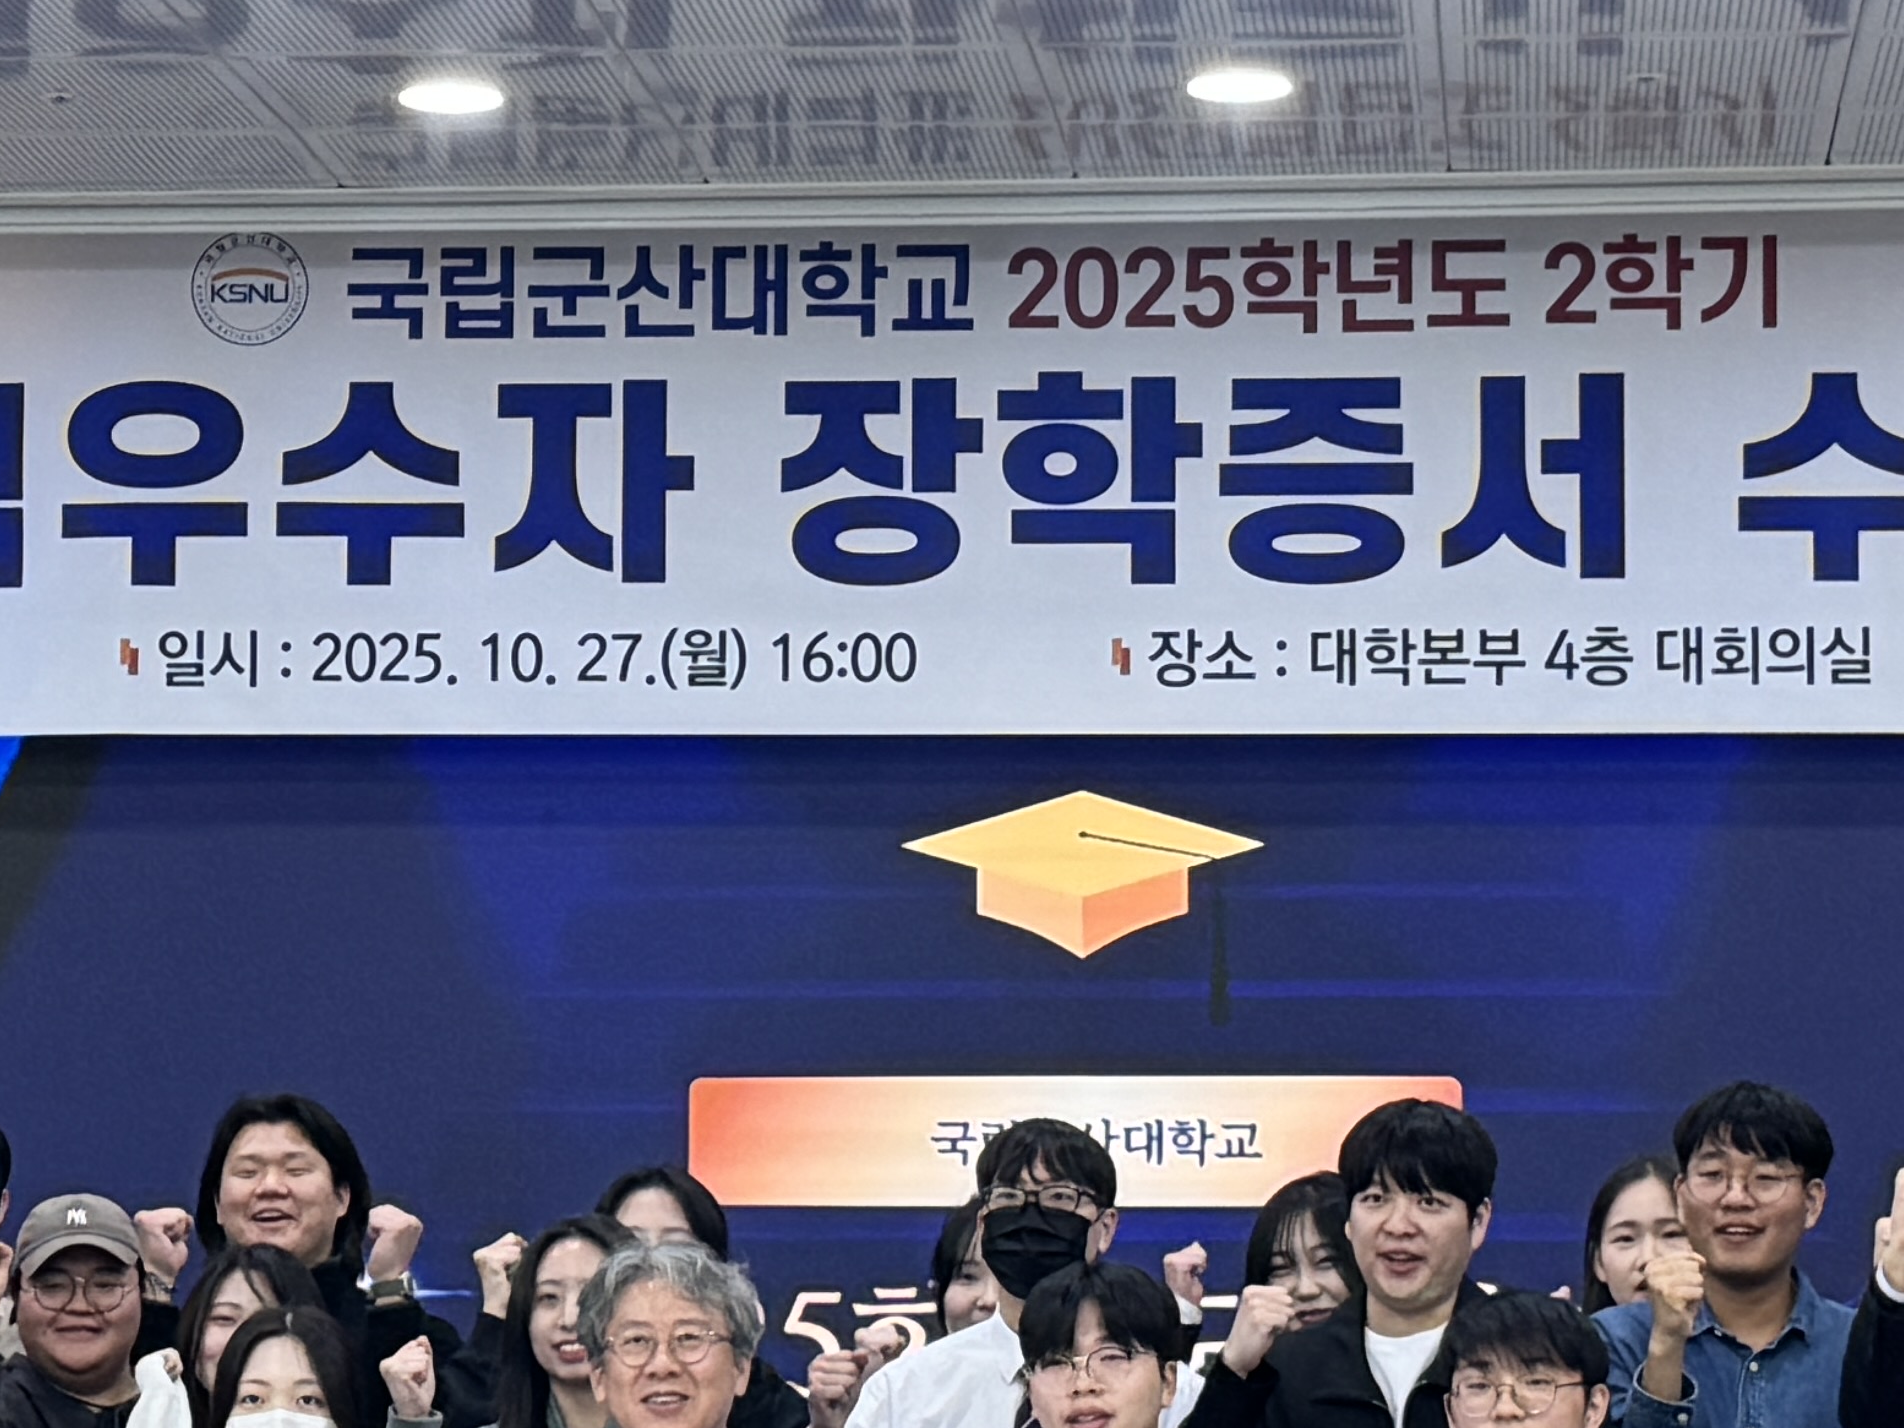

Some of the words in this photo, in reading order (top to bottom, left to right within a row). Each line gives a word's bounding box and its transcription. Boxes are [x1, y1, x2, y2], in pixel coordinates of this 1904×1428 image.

[210, 282, 289, 304] KSNU
[347, 241, 976, 339] 국립군산대학교
[1005, 237, 1512, 336] 2025학년도
[1540, 234, 1782, 334] 2학기
[781, 370, 1625, 586] 장학증서
[159, 629, 260, 687] 일시
[311, 631, 459, 686] 2025.
[481, 631, 558, 686] 10.
[577, 626, 748, 691] 27.(월)
[771, 630, 919, 684] 16:00
[1148, 628, 1257, 688] 장소
[1310, 627, 1527, 687] 대학본부
[1543, 625, 1635, 687] 4층
[1655, 625, 1872, 686] 대회의실
